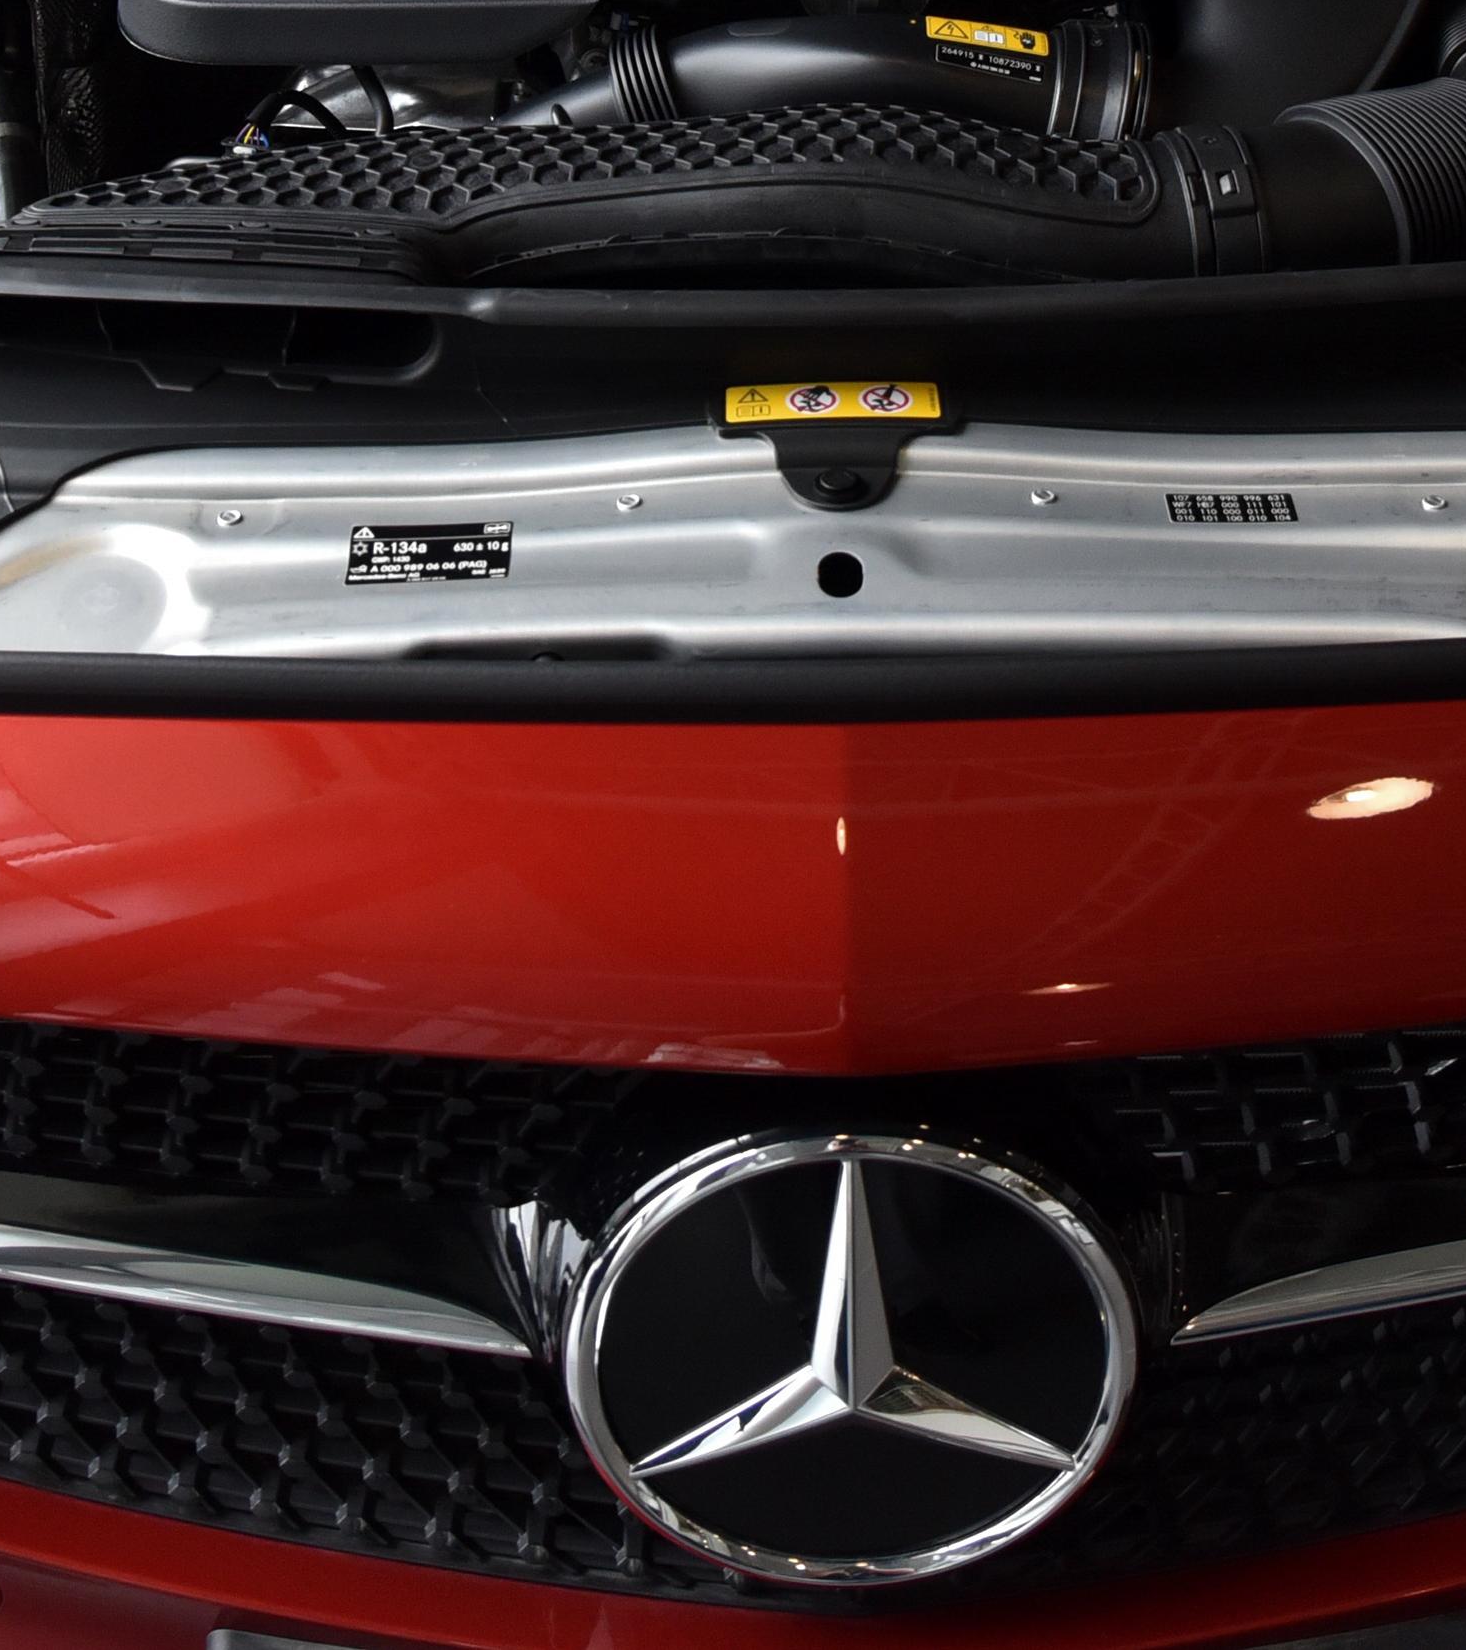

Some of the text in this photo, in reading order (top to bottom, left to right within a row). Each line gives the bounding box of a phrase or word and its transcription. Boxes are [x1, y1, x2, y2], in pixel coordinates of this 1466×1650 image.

[941, 46, 974, 59] 264915
[988, 56, 1032, 71] 10872390
[372, 541, 427, 555] R-134a
[453, 542, 474, 552] 630
[487, 541, 500, 551] 10
[370, 559, 488, 573] A 000 989 06 06 (PAG)
